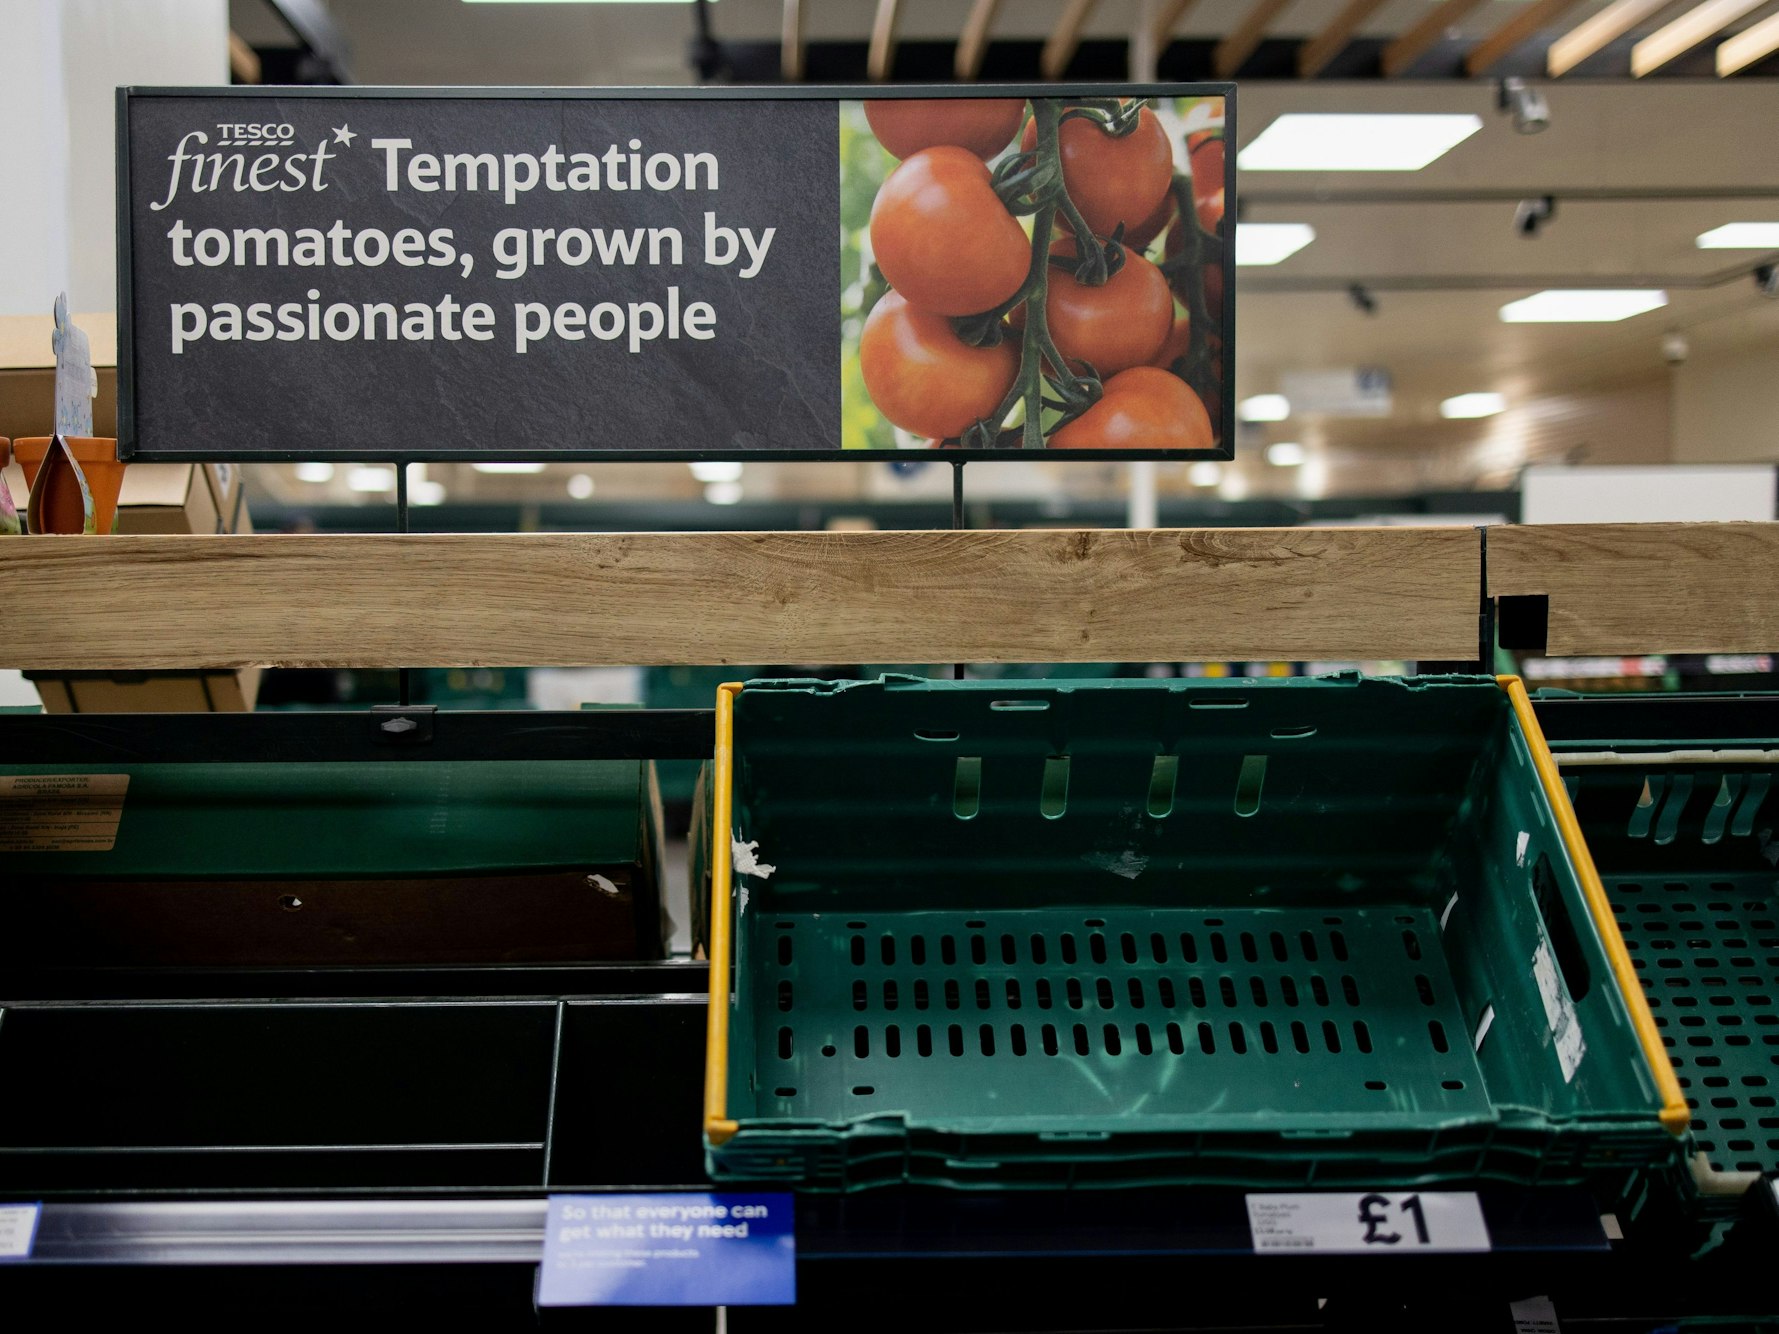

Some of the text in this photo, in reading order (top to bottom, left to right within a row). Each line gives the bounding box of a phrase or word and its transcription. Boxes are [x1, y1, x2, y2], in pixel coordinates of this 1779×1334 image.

[217, 124, 295, 138] TESCO
[150, 131, 719, 211] finest Temptation
[168, 211, 777, 280] tomatoes, grown by
[171, 285, 717, 354] passionate people
[559, 1222, 749, 1243] get what they need
[562, 1204, 768, 1222] So that everyone can
[1358, 1193, 1431, 1244] £1
